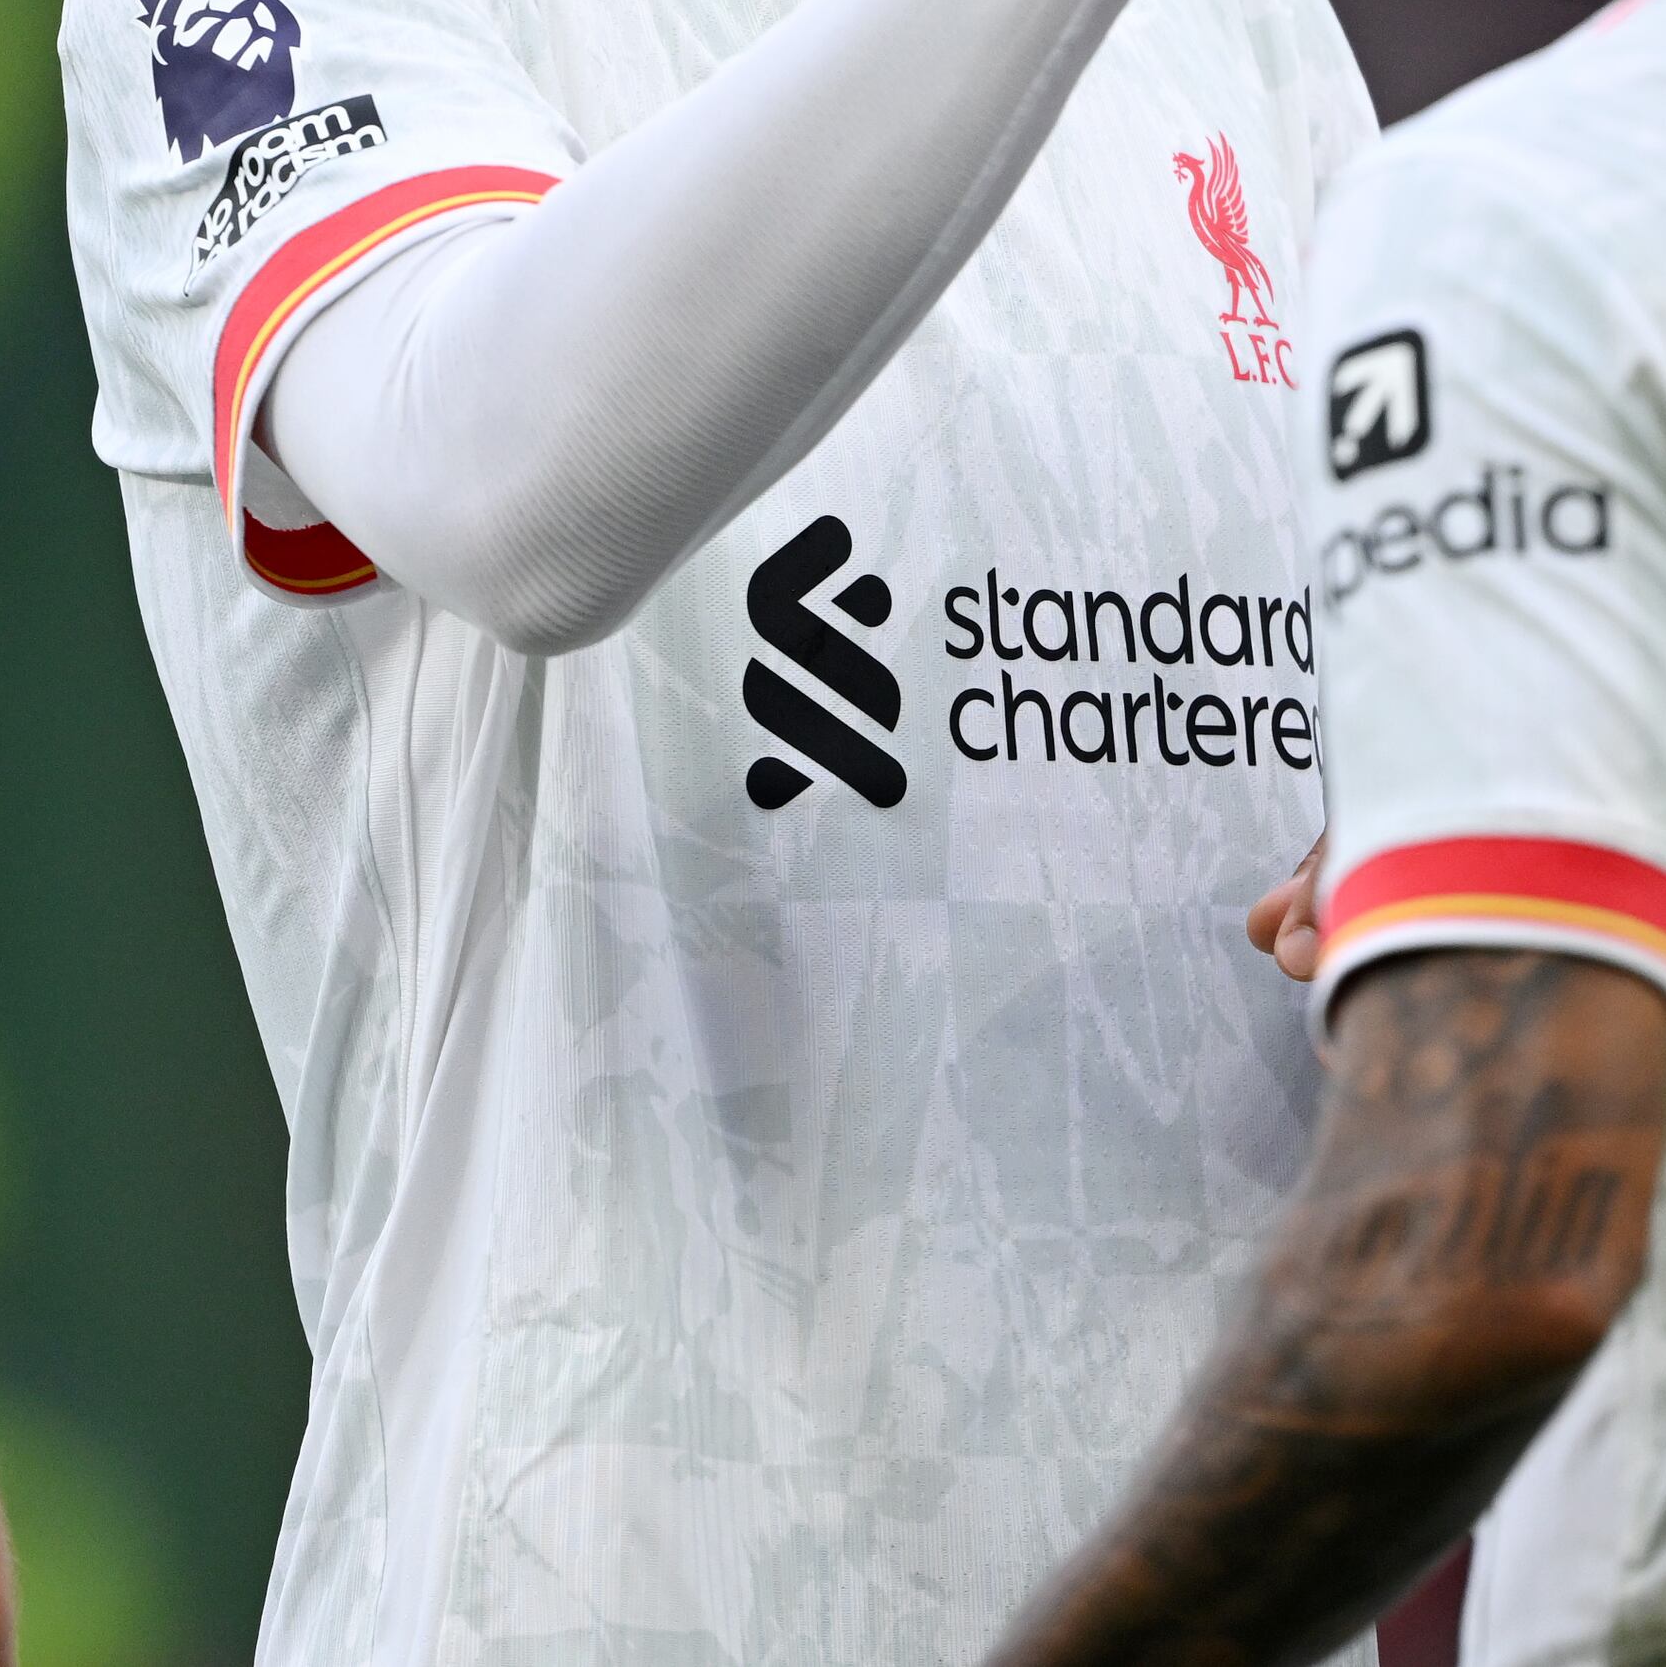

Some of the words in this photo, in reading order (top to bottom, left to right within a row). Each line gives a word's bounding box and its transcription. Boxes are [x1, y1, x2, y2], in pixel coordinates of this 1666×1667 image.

[234, 106, 351, 205] room
[238, 125, 385, 235] racism
[945, 567, 1315, 676] standard
